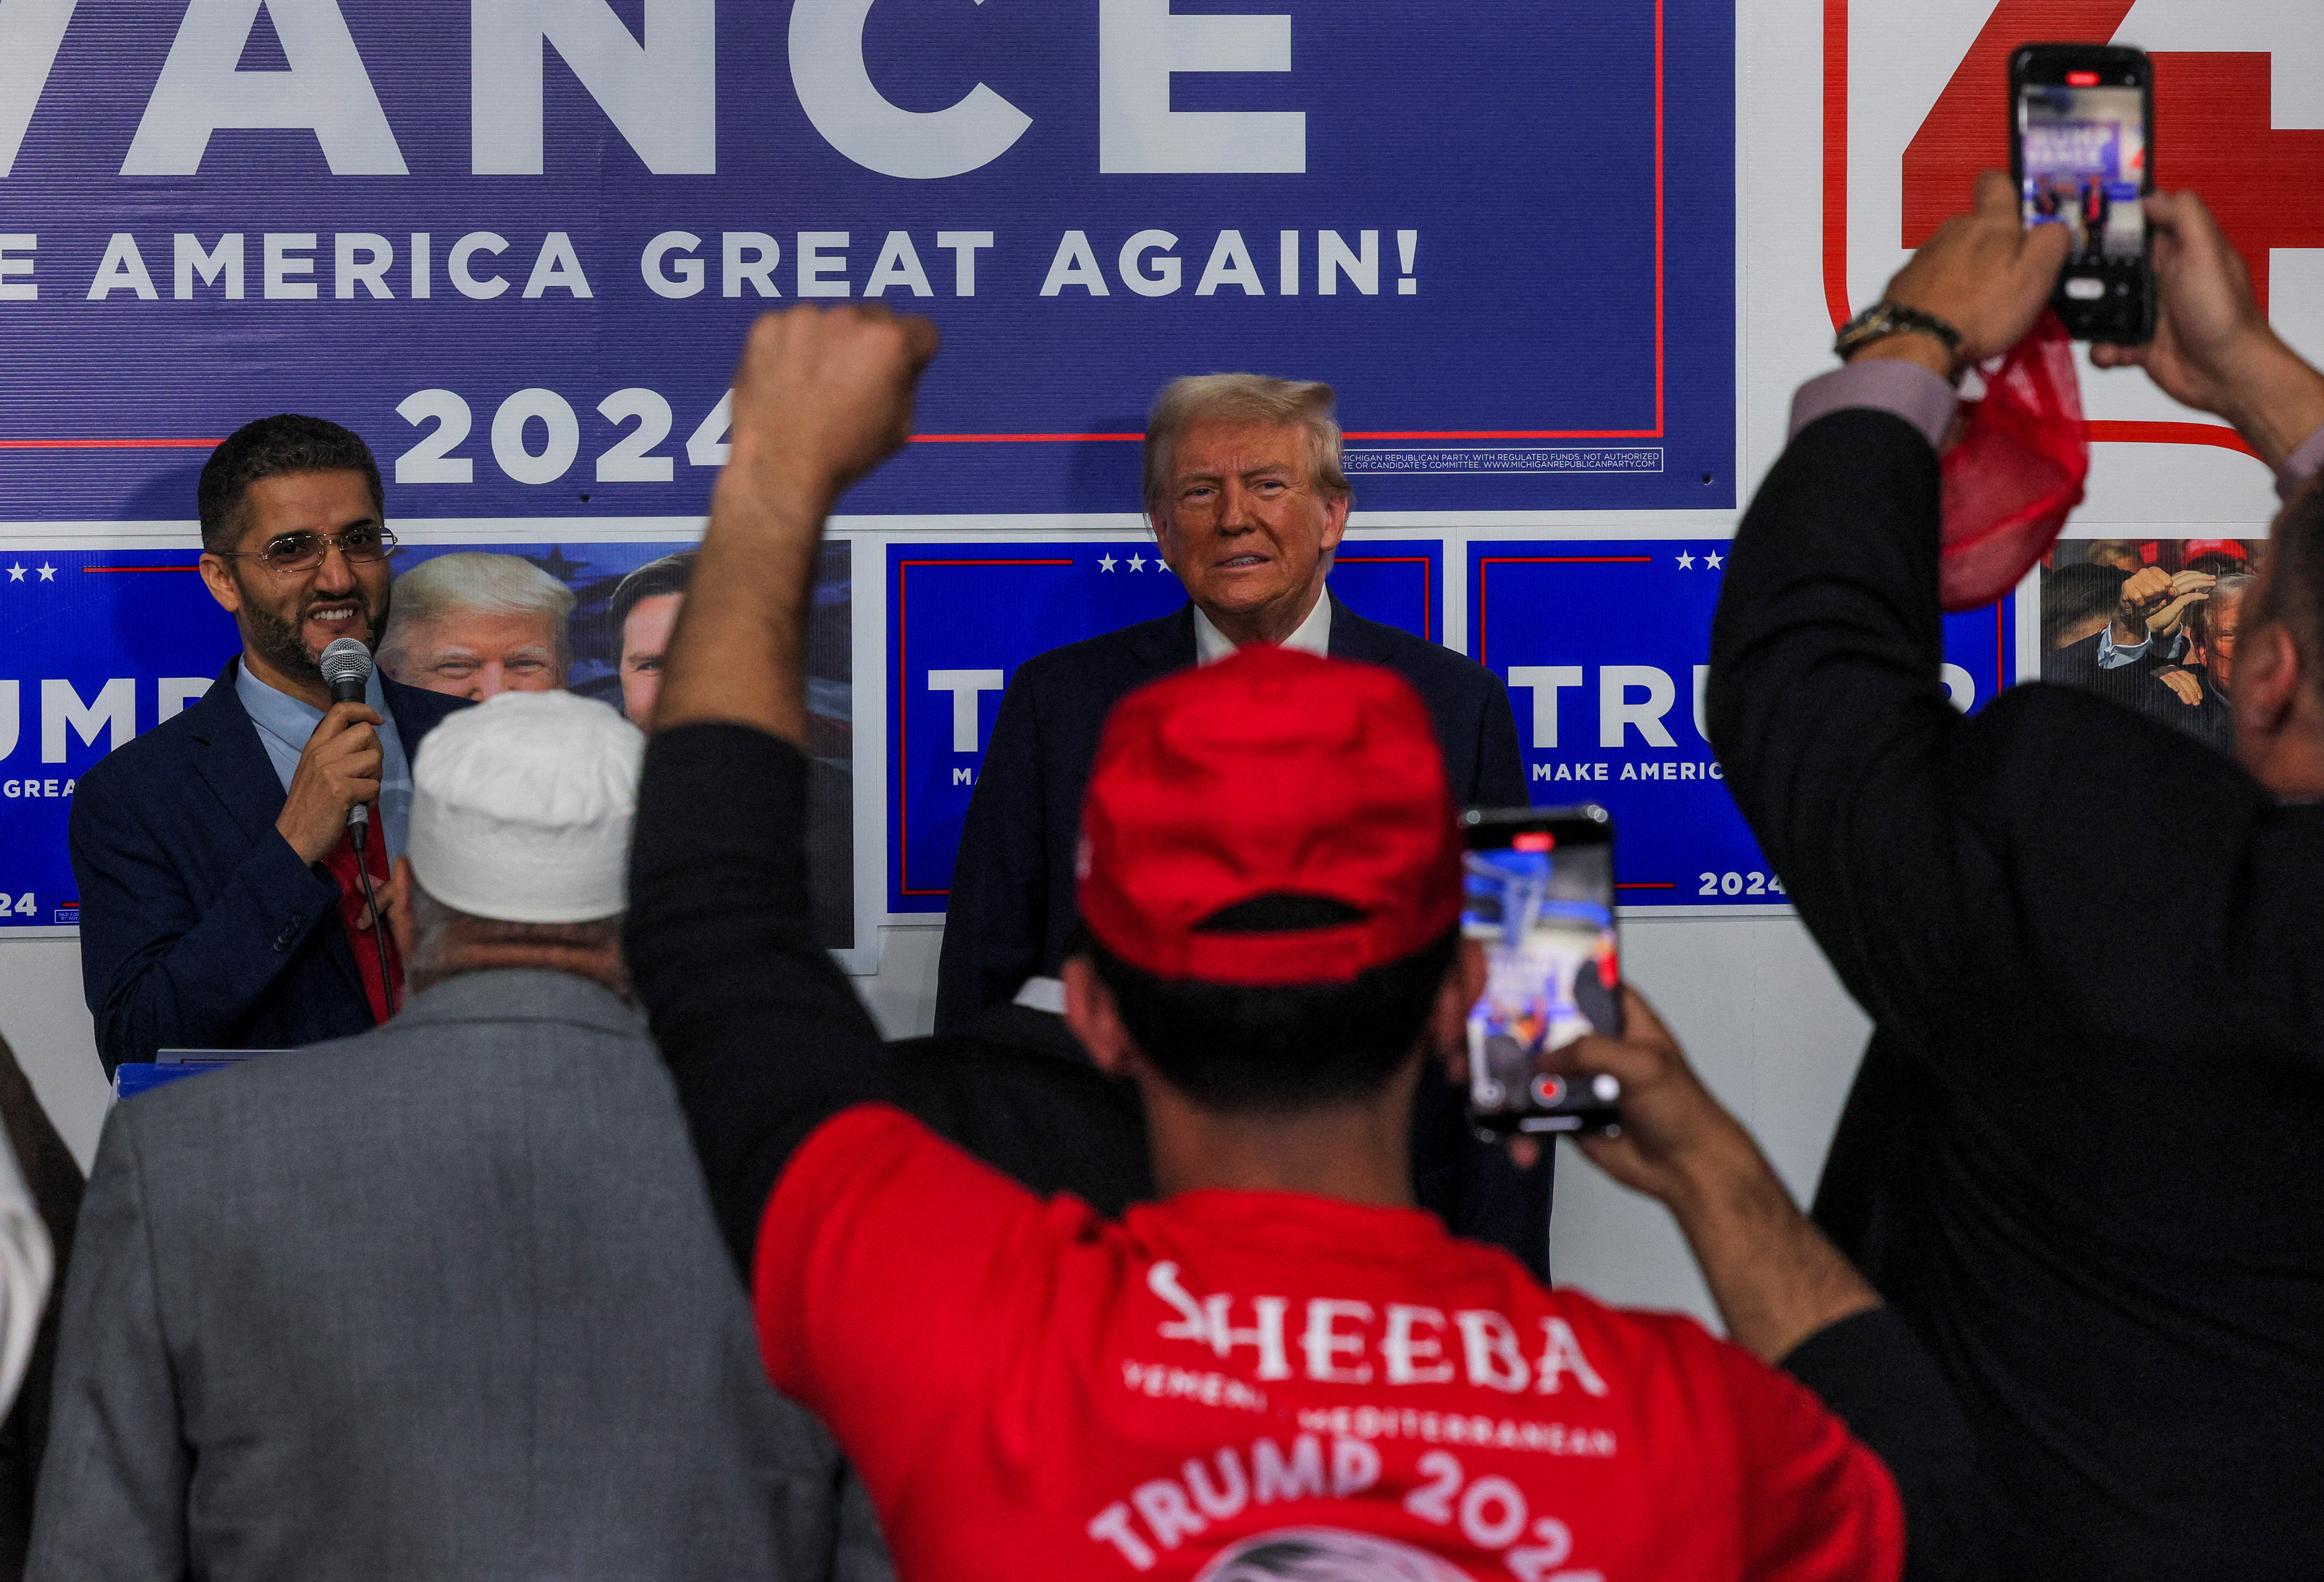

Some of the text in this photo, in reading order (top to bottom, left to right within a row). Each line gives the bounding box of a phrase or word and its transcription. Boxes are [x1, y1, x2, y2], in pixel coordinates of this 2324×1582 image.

[0, 0, 1306, 179] ANCE
[86, 231, 593, 299] AMERICA
[641, 230, 994, 299] GREAT
[1039, 229, 1418, 297] AGAIN!
[1533, 763, 1609, 781] MAKE
[1147, 1259, 1609, 1398] SHEEBA
[1086, 1431, 1608, 1582] TRUMP 202
